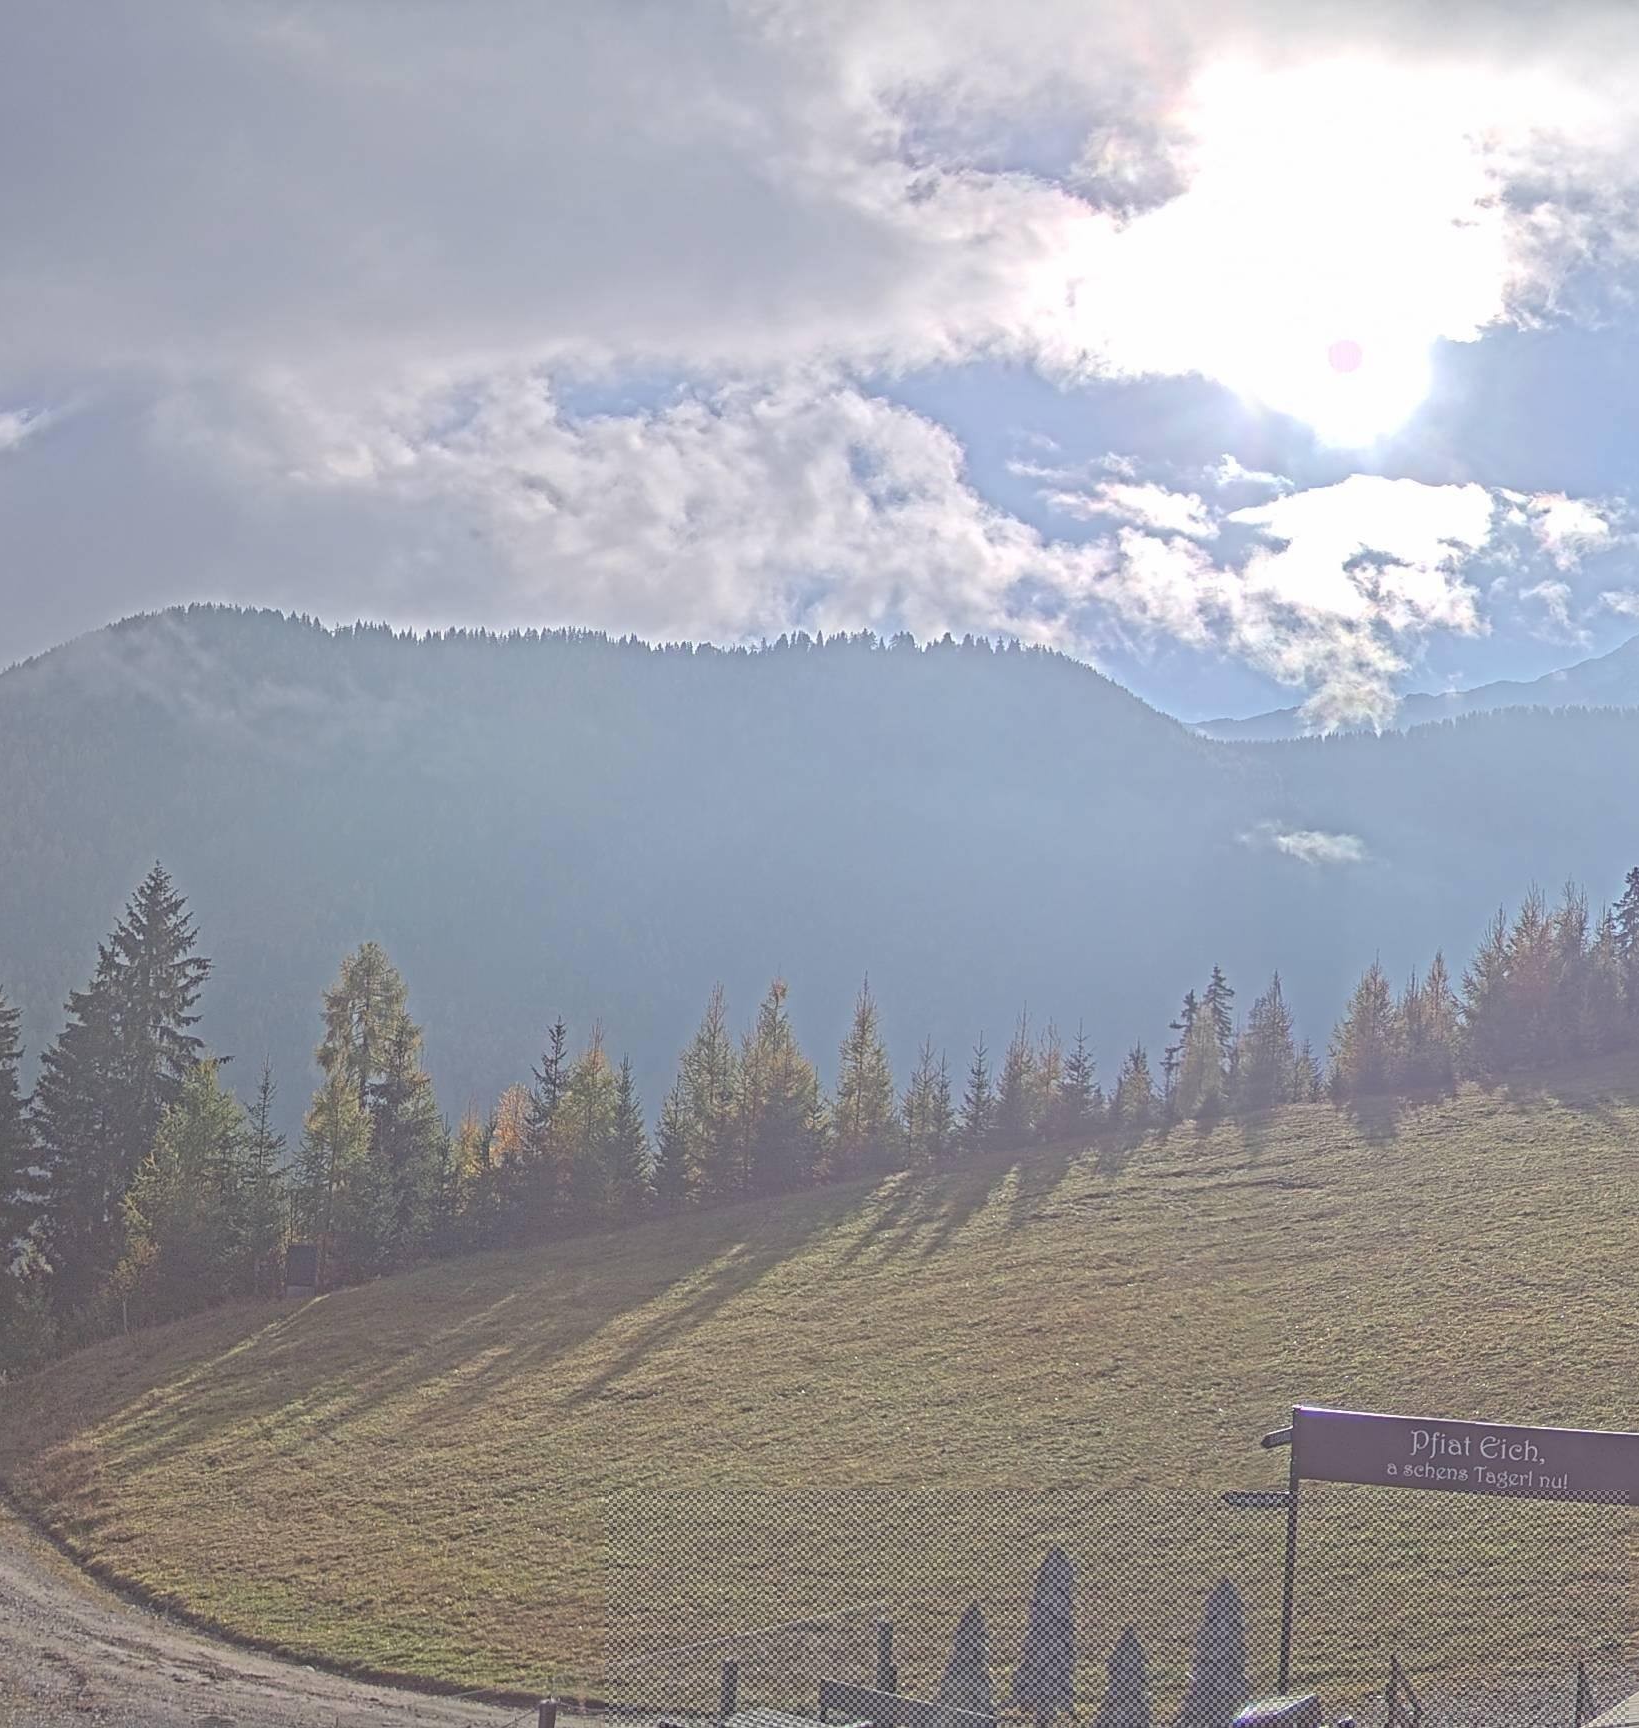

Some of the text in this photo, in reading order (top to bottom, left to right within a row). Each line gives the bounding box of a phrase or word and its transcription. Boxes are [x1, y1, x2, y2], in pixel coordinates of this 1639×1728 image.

[1410, 1430, 1545, 1465] Pfiat Eich,
[1387, 1462, 1568, 1490] a schens Tagerl nu!
